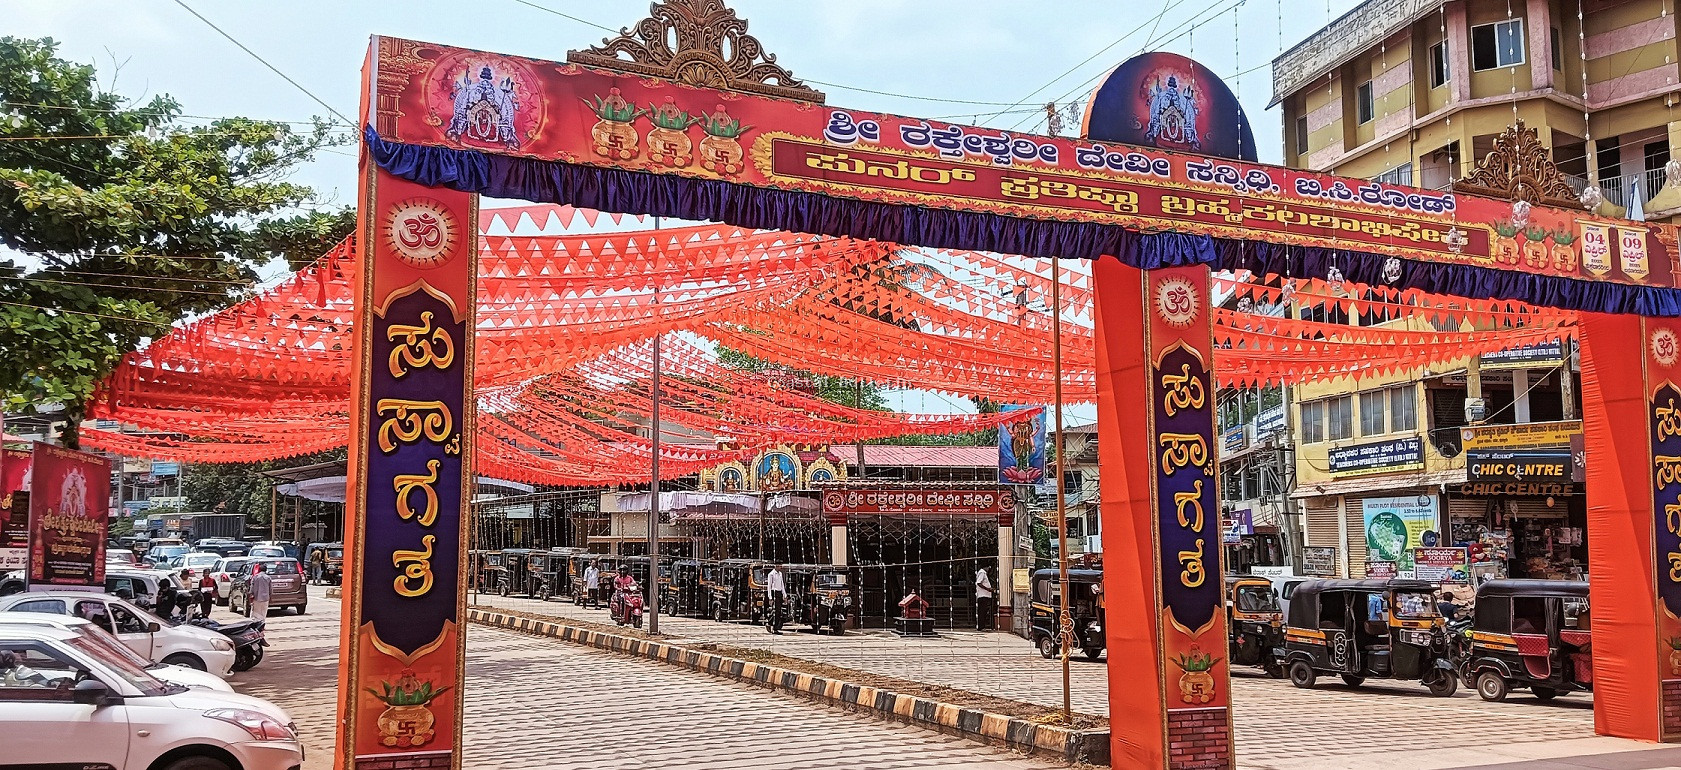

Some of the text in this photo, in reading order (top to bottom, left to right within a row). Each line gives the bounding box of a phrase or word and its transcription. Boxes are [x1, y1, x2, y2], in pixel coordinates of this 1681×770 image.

[823, 110, 880, 145] ಶ್ರೀ
[1077, 144, 1170, 176] ದೇವೀ
[1585, 232, 1605, 245] 04
[1623, 237, 1642, 249] 09
[1471, 463, 1564, 476] CHIC CENTRE
[1461, 482, 1574, 497] CHIC CENTRE
